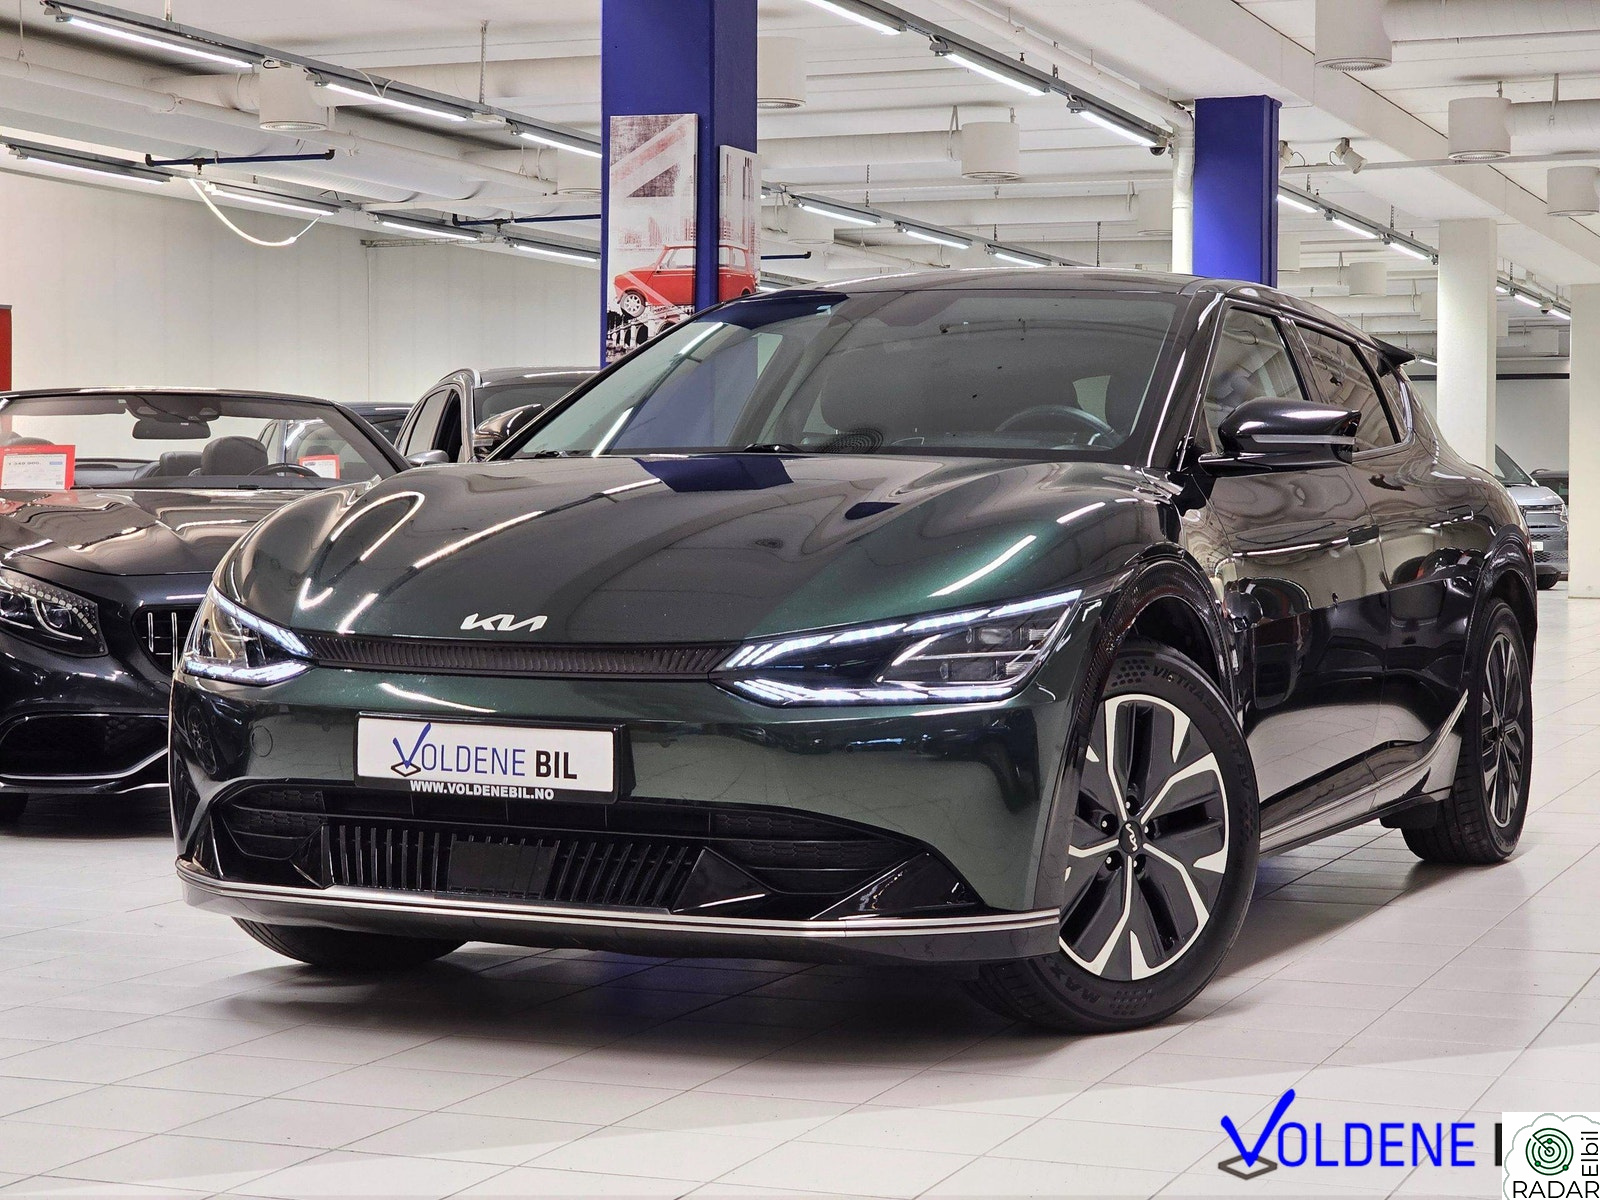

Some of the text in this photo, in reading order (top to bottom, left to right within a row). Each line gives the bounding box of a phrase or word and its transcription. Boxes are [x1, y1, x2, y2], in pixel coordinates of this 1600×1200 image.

[460, 613, 548, 632] KIA
[392, 722, 578, 780] VOLDENE BIL
[410, 780, 555, 800] WWW.VOLDENEBIL.NO
